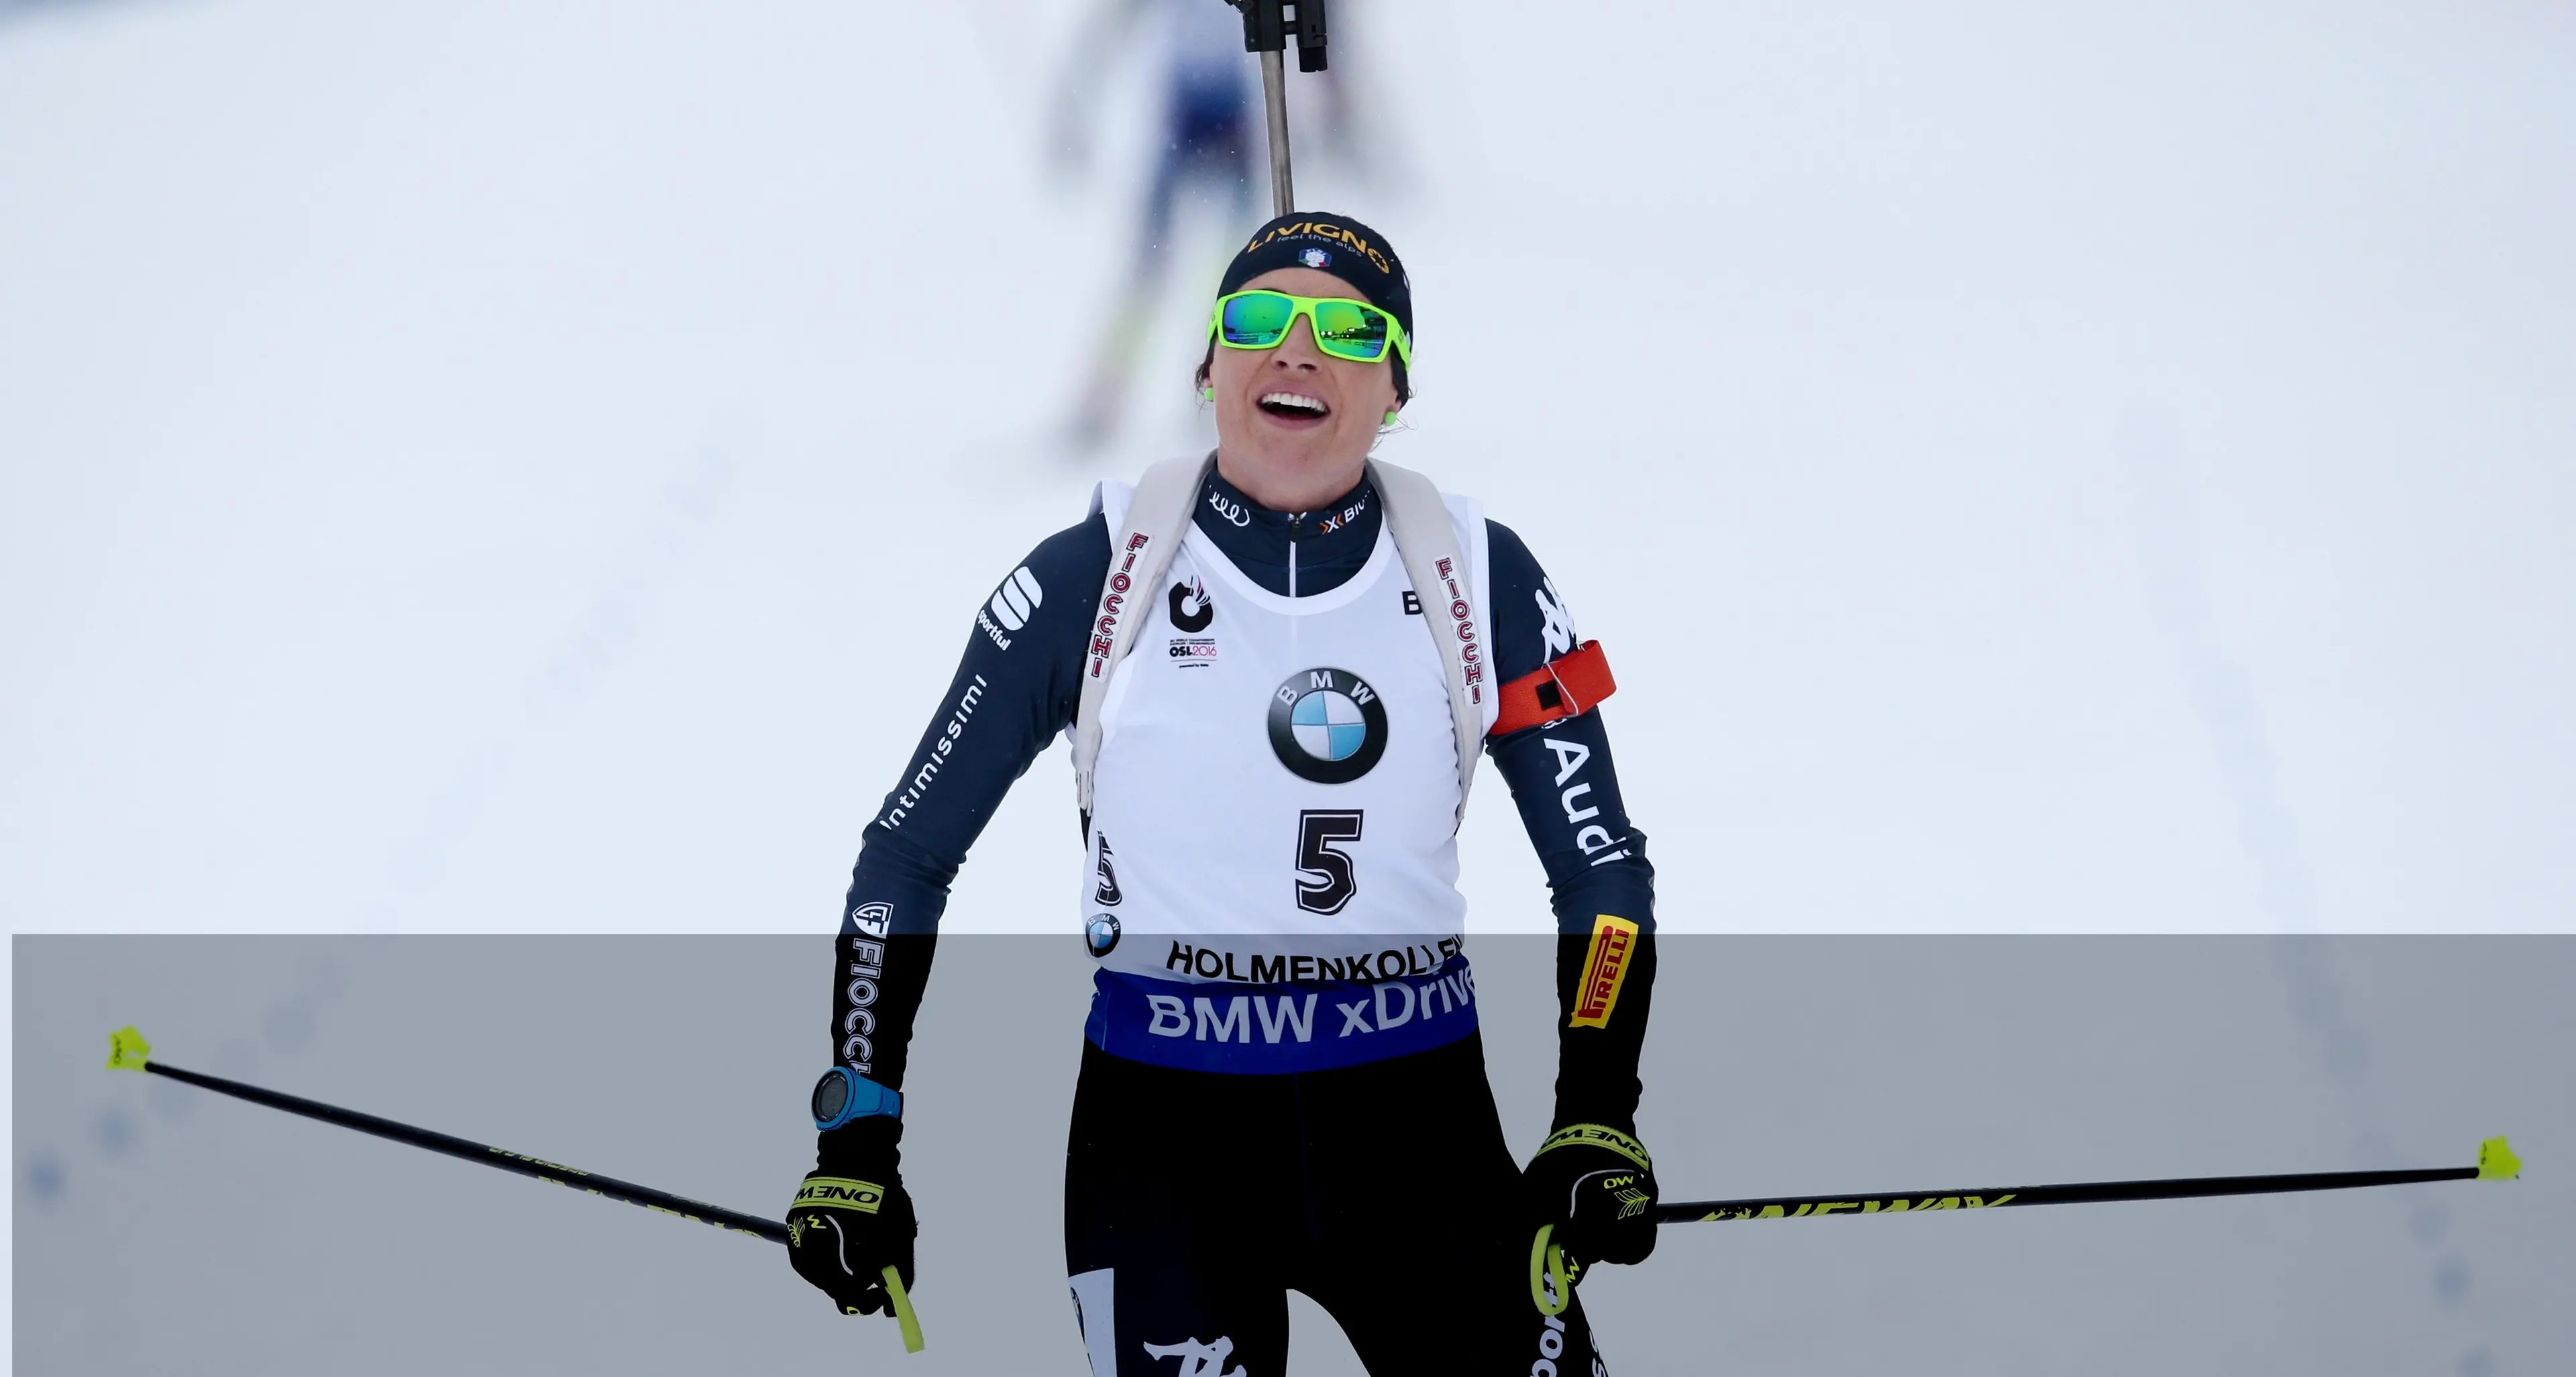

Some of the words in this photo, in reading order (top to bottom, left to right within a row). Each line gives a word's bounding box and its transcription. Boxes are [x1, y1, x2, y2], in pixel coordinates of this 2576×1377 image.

[1247, 223, 1390, 274] LIVIGNO
[1277, 233, 1303, 242] feel
[1309, 234, 1332, 243] the
[1336, 241, 1362, 257] alps
[977, 609, 1012, 651] sportful
[1091, 533, 1149, 677] FIOCCHI
[1436, 557, 1483, 704] FIOCCHI
[1277, 671, 1375, 706] BMW
[1544, 738, 1633, 867] Audi
[1295, 809, 1364, 916] 5
[1088, 914, 1120, 931] BMW
[1578, 926, 1629, 1018] PIRELLI
[1145, 993, 1318, 1044] BMW
